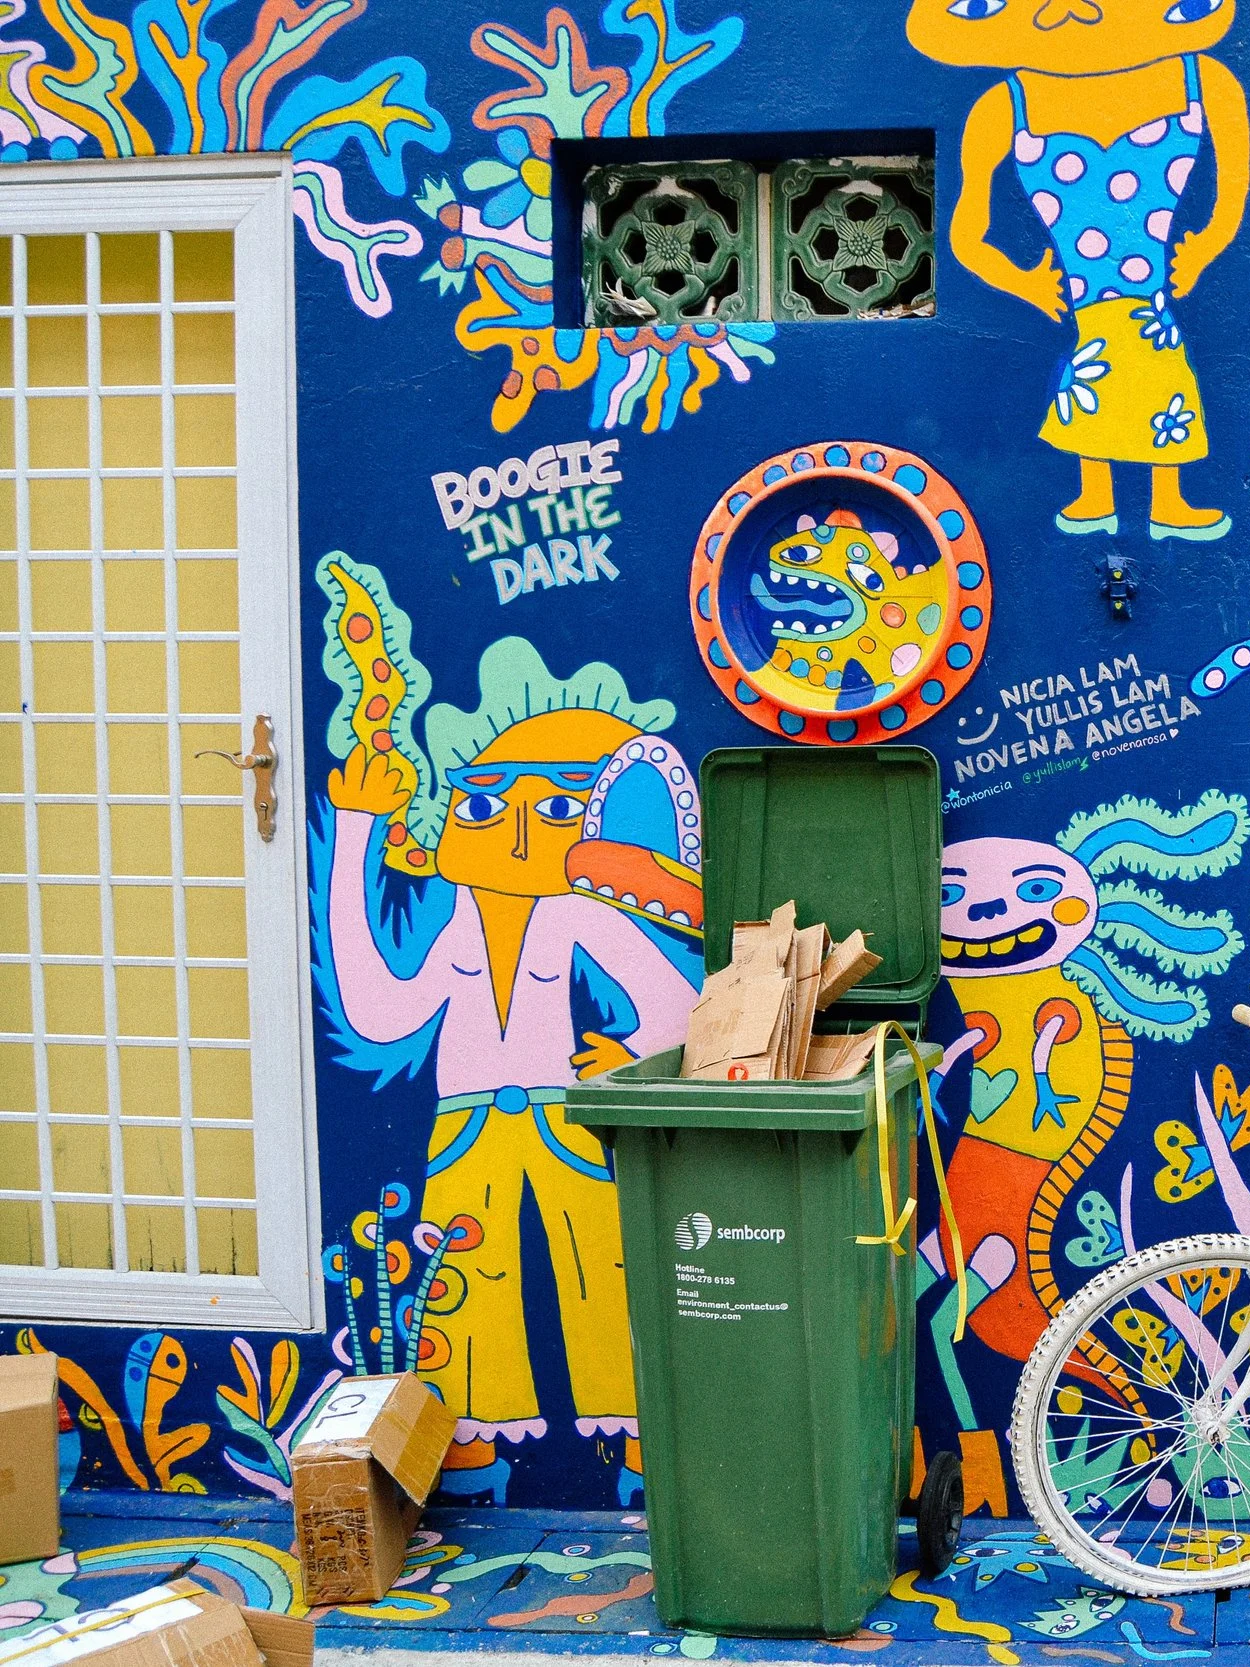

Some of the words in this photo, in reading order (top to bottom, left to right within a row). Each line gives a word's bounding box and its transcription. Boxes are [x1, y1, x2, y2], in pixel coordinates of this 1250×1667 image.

[431, 439, 622, 530] BOOGIE
[459, 503, 526, 563] IN
[527, 484, 622, 537] THE
[489, 533, 620, 605] DARK
[1000, 673, 1075, 709] NICIA
[1080, 653, 1141, 689] LAM
[1015, 690, 1104, 735] YULLIS
[1113, 673, 1172, 708] LAM
[953, 728, 1075, 784] NOVENA
[1085, 695, 1202, 748] ANGELA
[941, 781, 1013, 814] @wontonicia
[1022, 757, 1081, 784] @yullislam
[1092, 734, 1168, 761] @novenarosa
[717, 1225, 786, 1243] sembcorp
[675, 1263, 705, 1274] Hotline
[676, 1273, 713, 1284] 1800-278
[714, 1276, 736, 1285] 6135
[676, 1288, 699, 1298] Email
[677, 1299, 789, 1311] environment_contactus@
[678, 1310, 742, 1321] sembcorp.com
